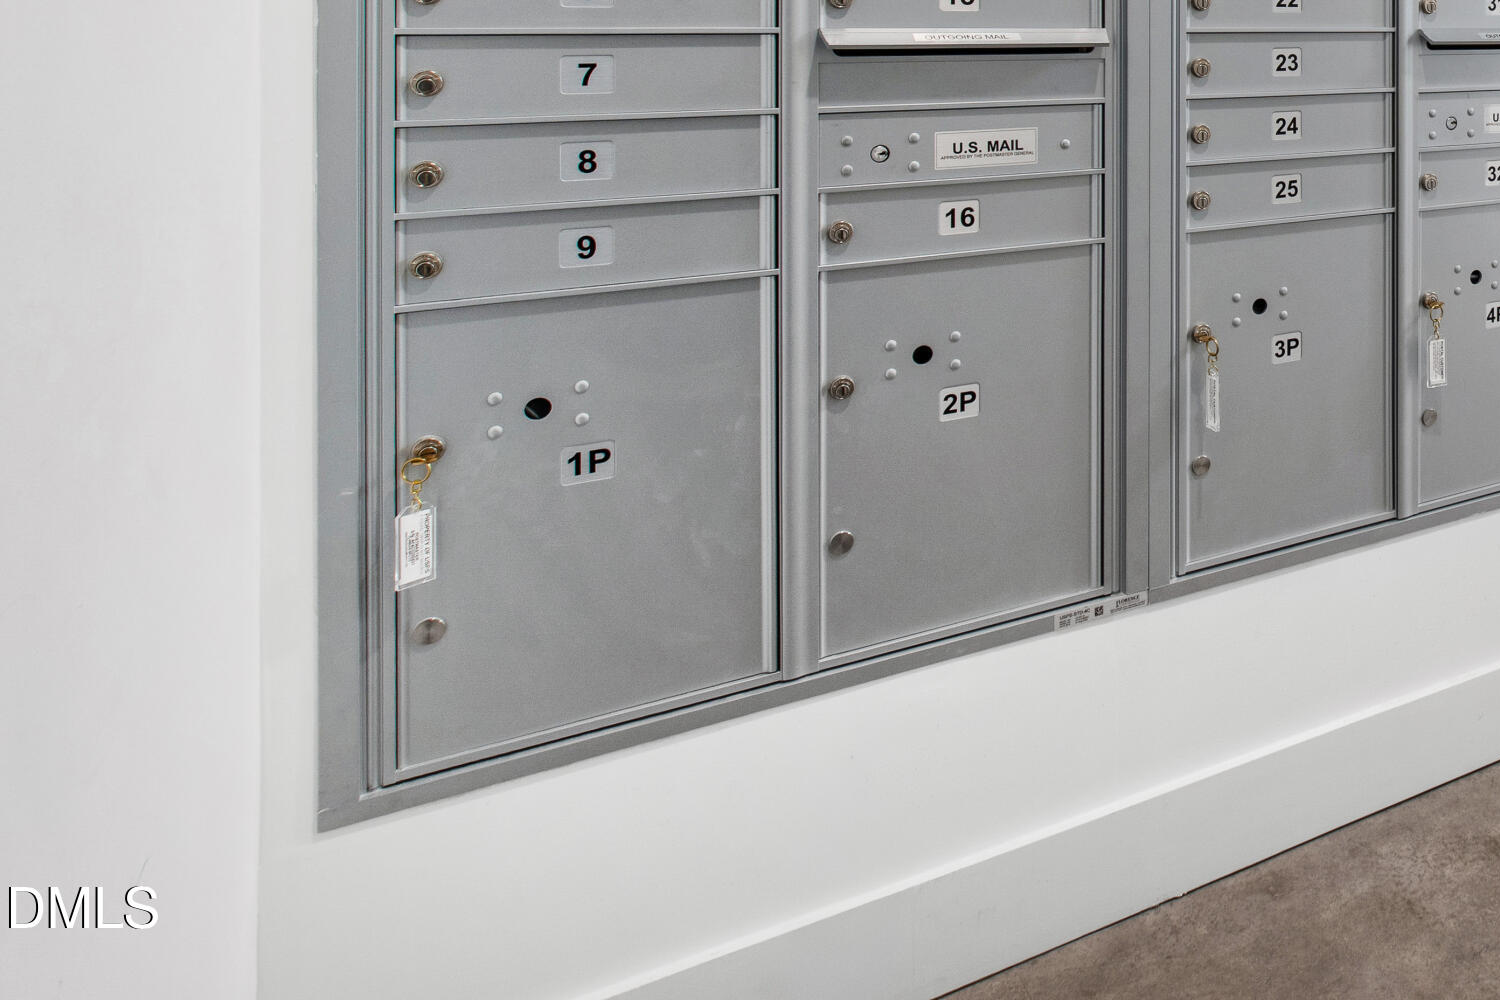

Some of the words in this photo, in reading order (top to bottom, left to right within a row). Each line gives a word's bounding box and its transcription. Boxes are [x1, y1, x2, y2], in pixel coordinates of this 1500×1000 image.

[1275, 53, 1299, 72] 23
[577, 62, 598, 87] 7
[1275, 116, 1299, 136] 24
[952, 141, 982, 155] U.S.
[987, 139, 1024, 153] MAIL
[577, 149, 597, 174] 8
[1275, 179, 1299, 199] 25
[945, 206, 975, 229] 16
[576, 235, 597, 260] 9
[1274, 337, 1300, 358] 3P
[942, 390, 977, 415] 2P
[567, 448, 612, 477] 1P
